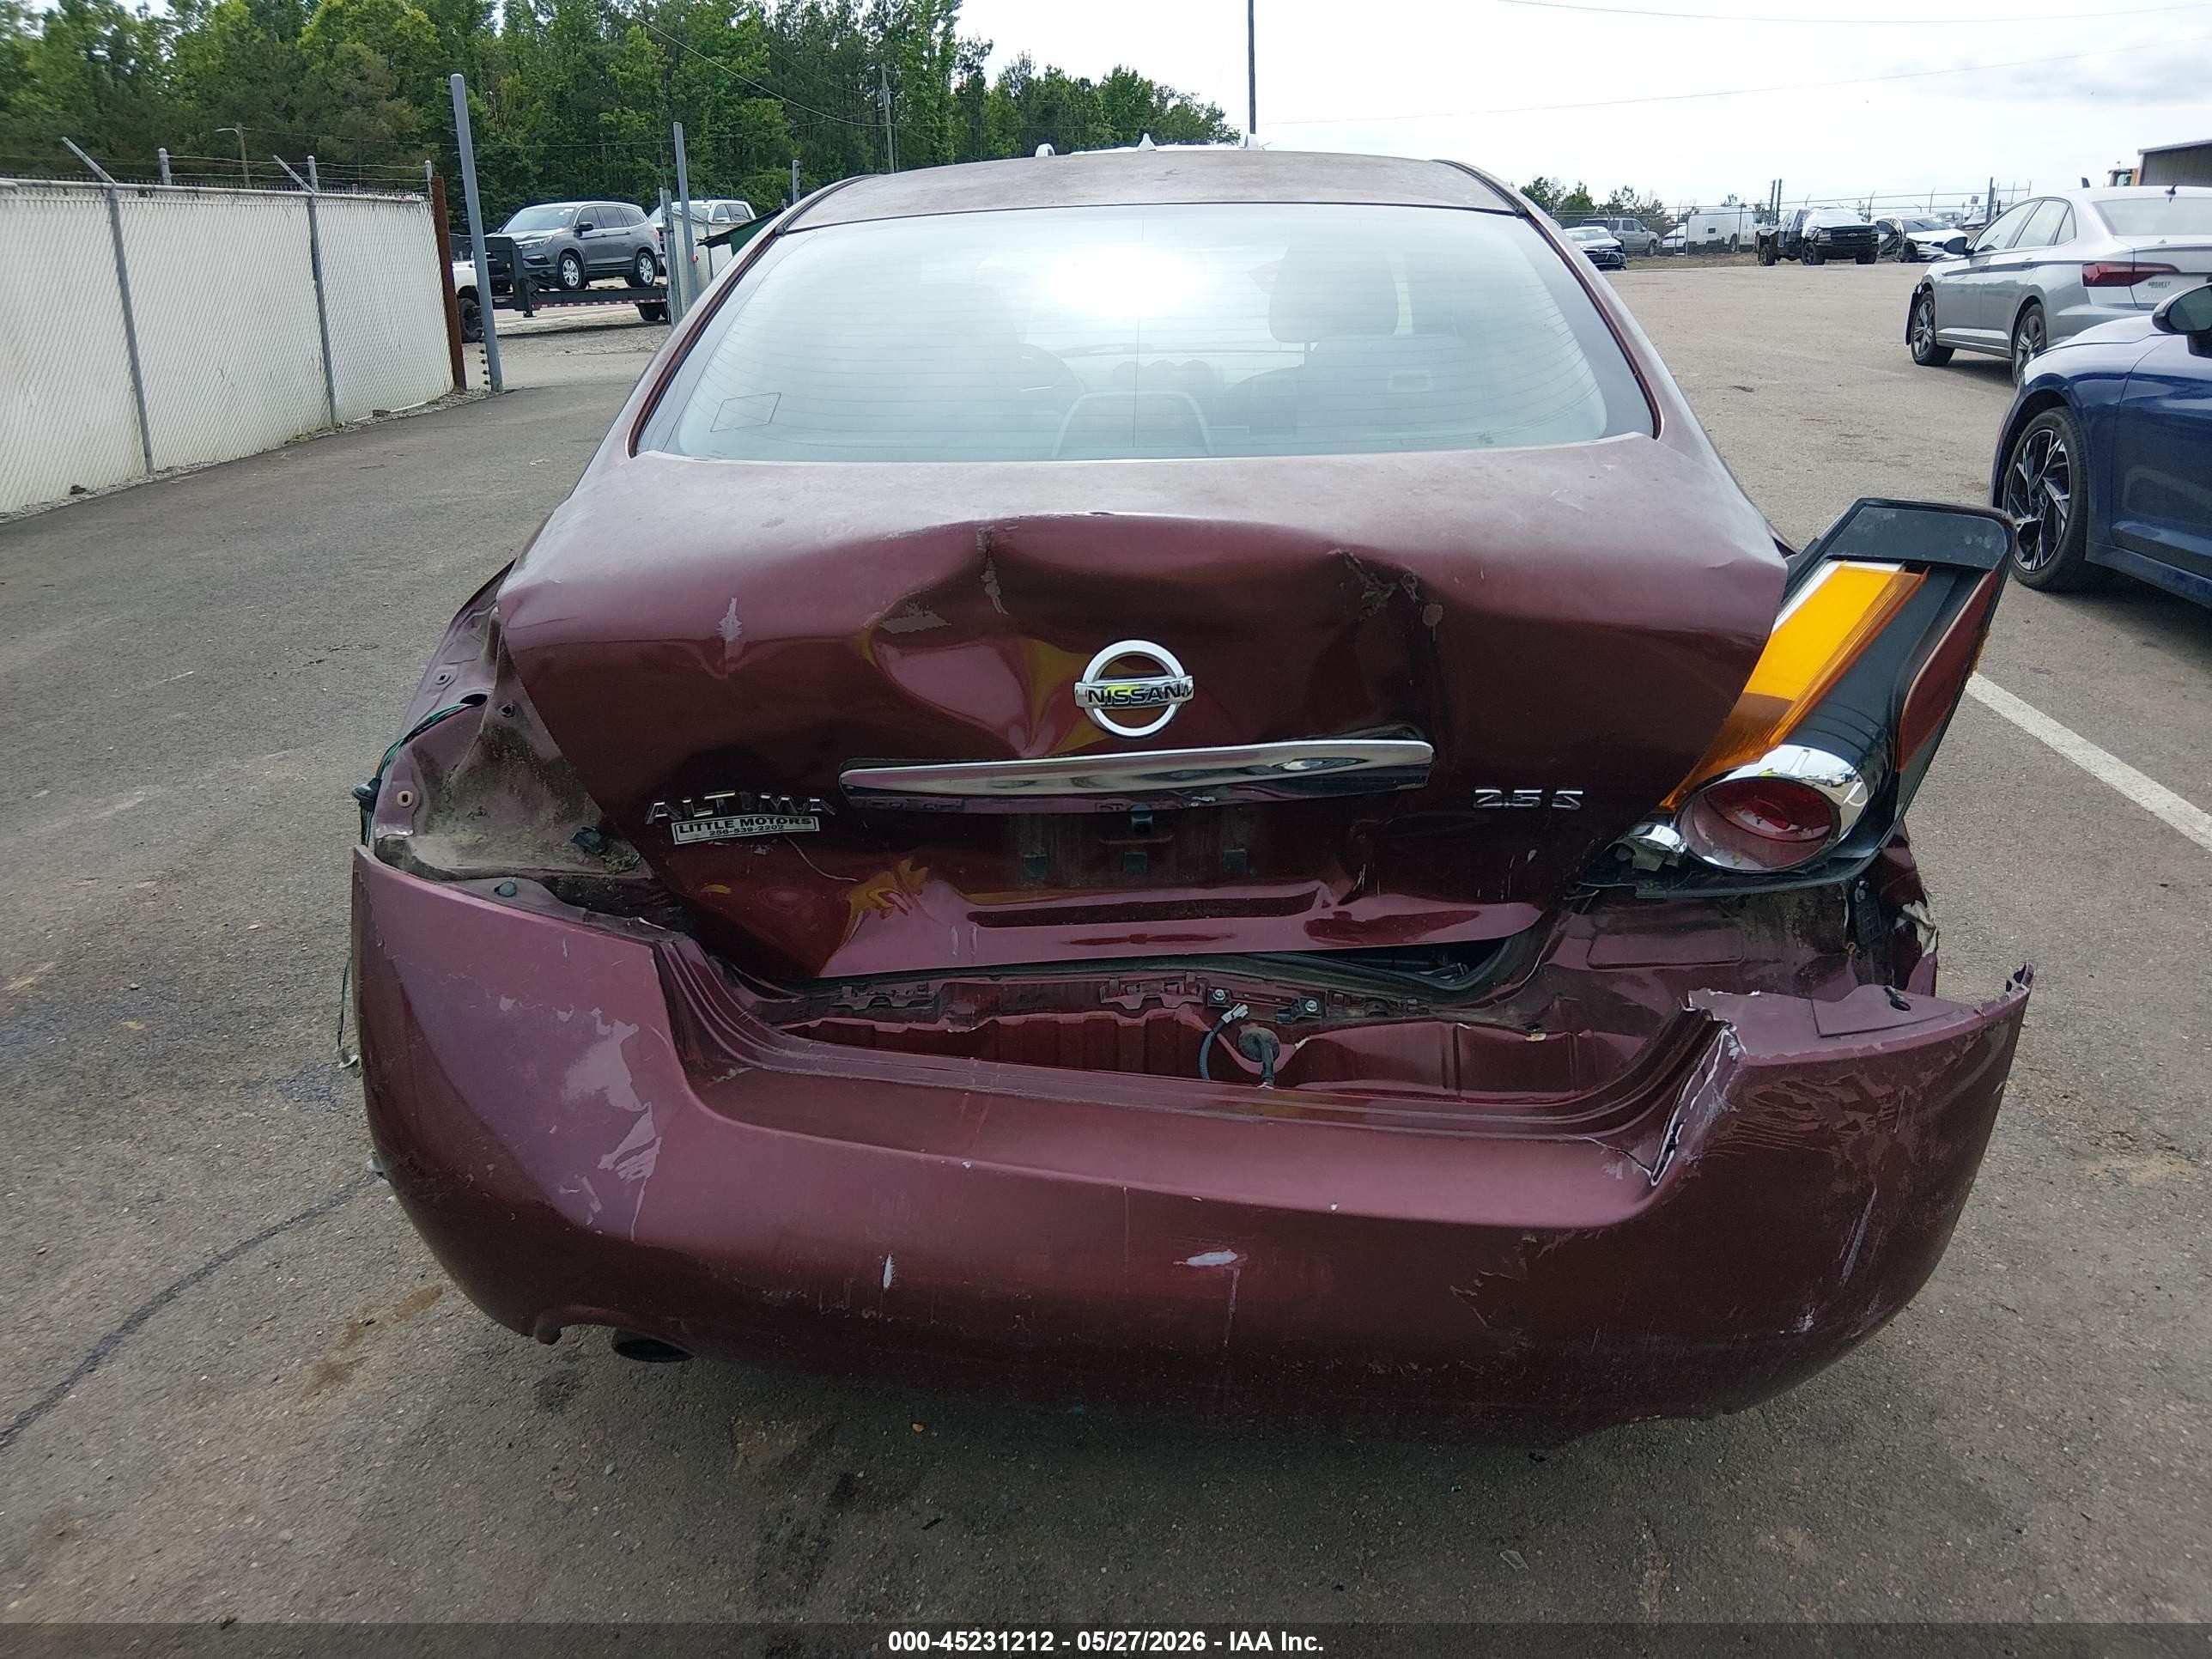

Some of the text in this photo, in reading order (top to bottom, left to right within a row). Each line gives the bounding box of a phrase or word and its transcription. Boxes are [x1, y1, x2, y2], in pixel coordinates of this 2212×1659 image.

[1088, 684, 1181, 704] NISSAN
[646, 790, 836, 824] ALTMA
[1473, 788, 1583, 810] 2.5 S
[679, 817, 812, 834] LITTLE MOTORS
[708, 824, 785, 836] 256-539-2202
